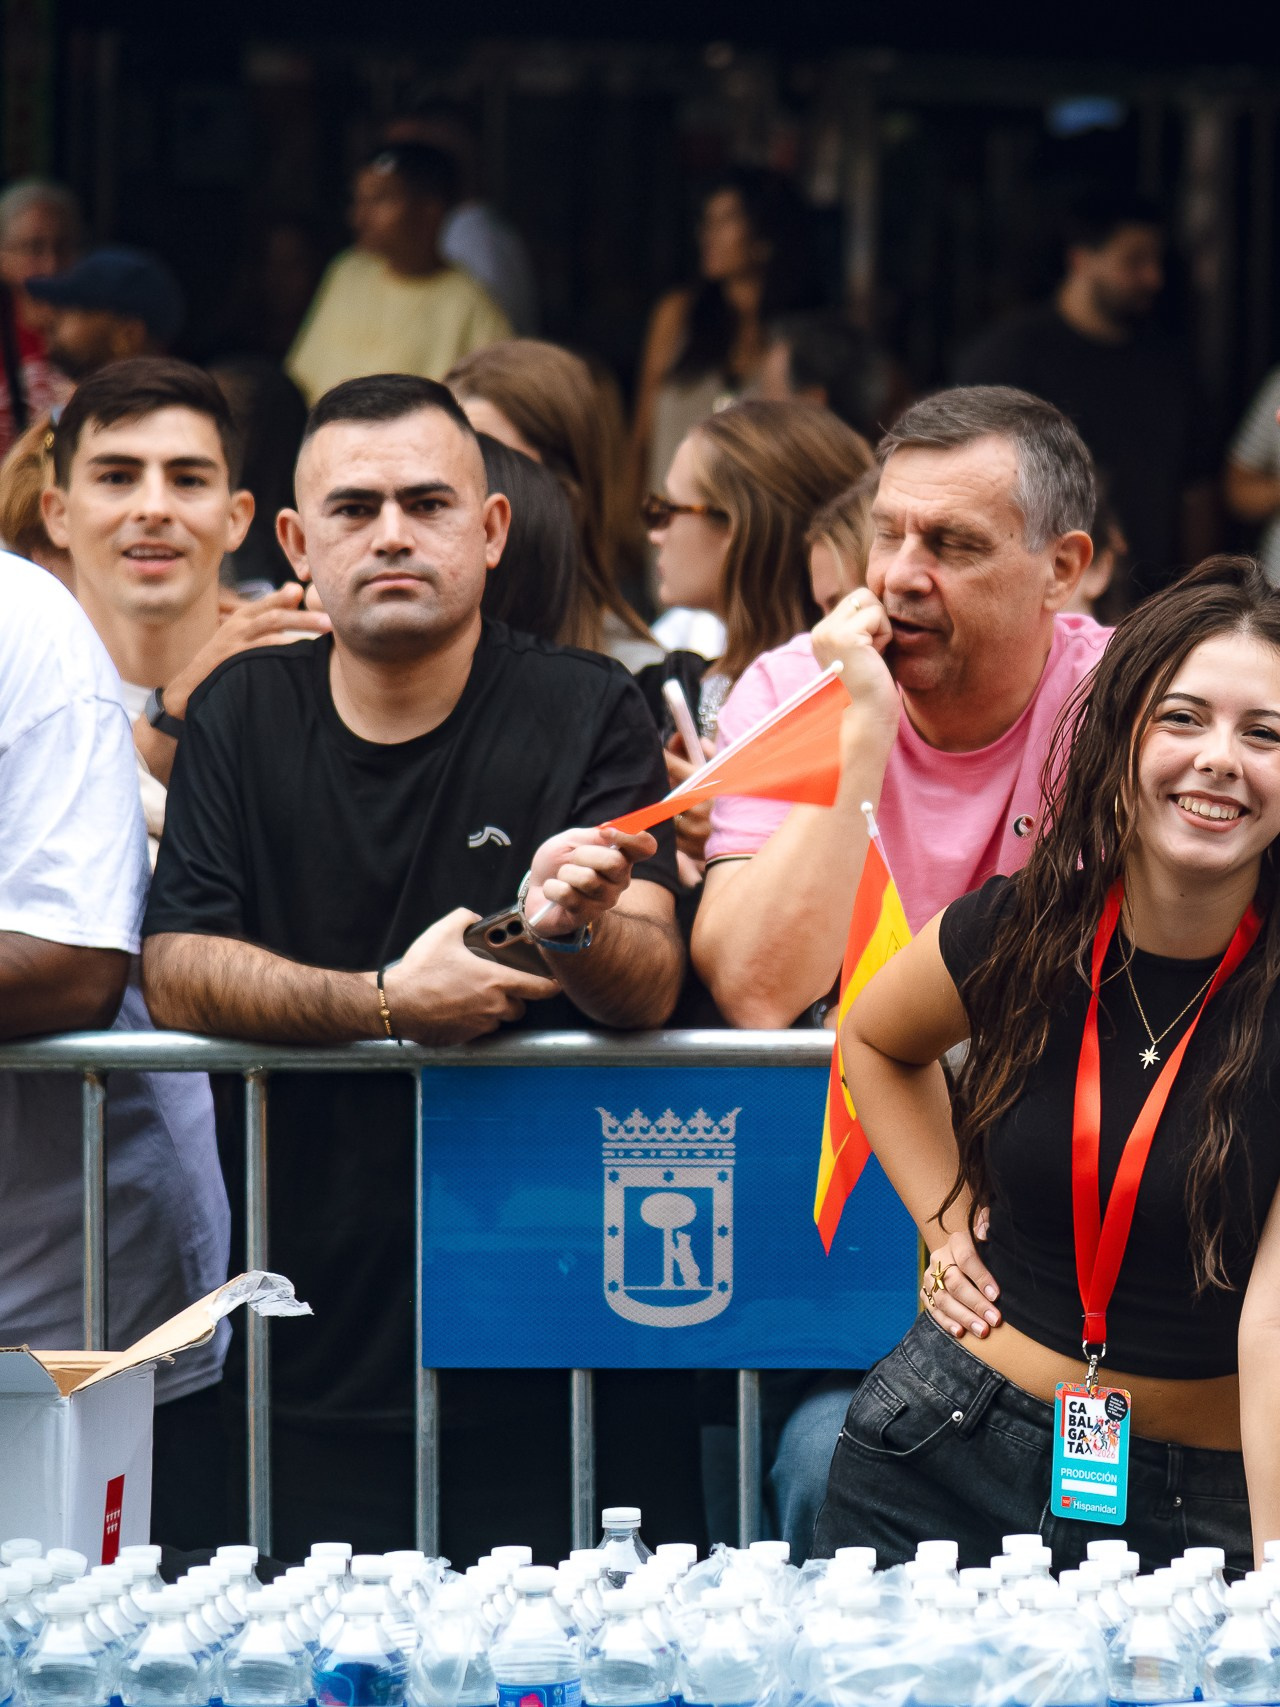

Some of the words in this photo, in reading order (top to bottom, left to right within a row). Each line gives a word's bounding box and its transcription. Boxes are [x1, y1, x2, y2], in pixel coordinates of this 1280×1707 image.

[1069, 1401, 1087, 1415] CA
[1068, 1414, 1094, 1430] BAL
[1067, 1428, 1087, 1441] GA
[1061, 1467, 1118, 1483] PRODUCCIÓN
[1073, 1500, 1117, 1515] Hispanidad
